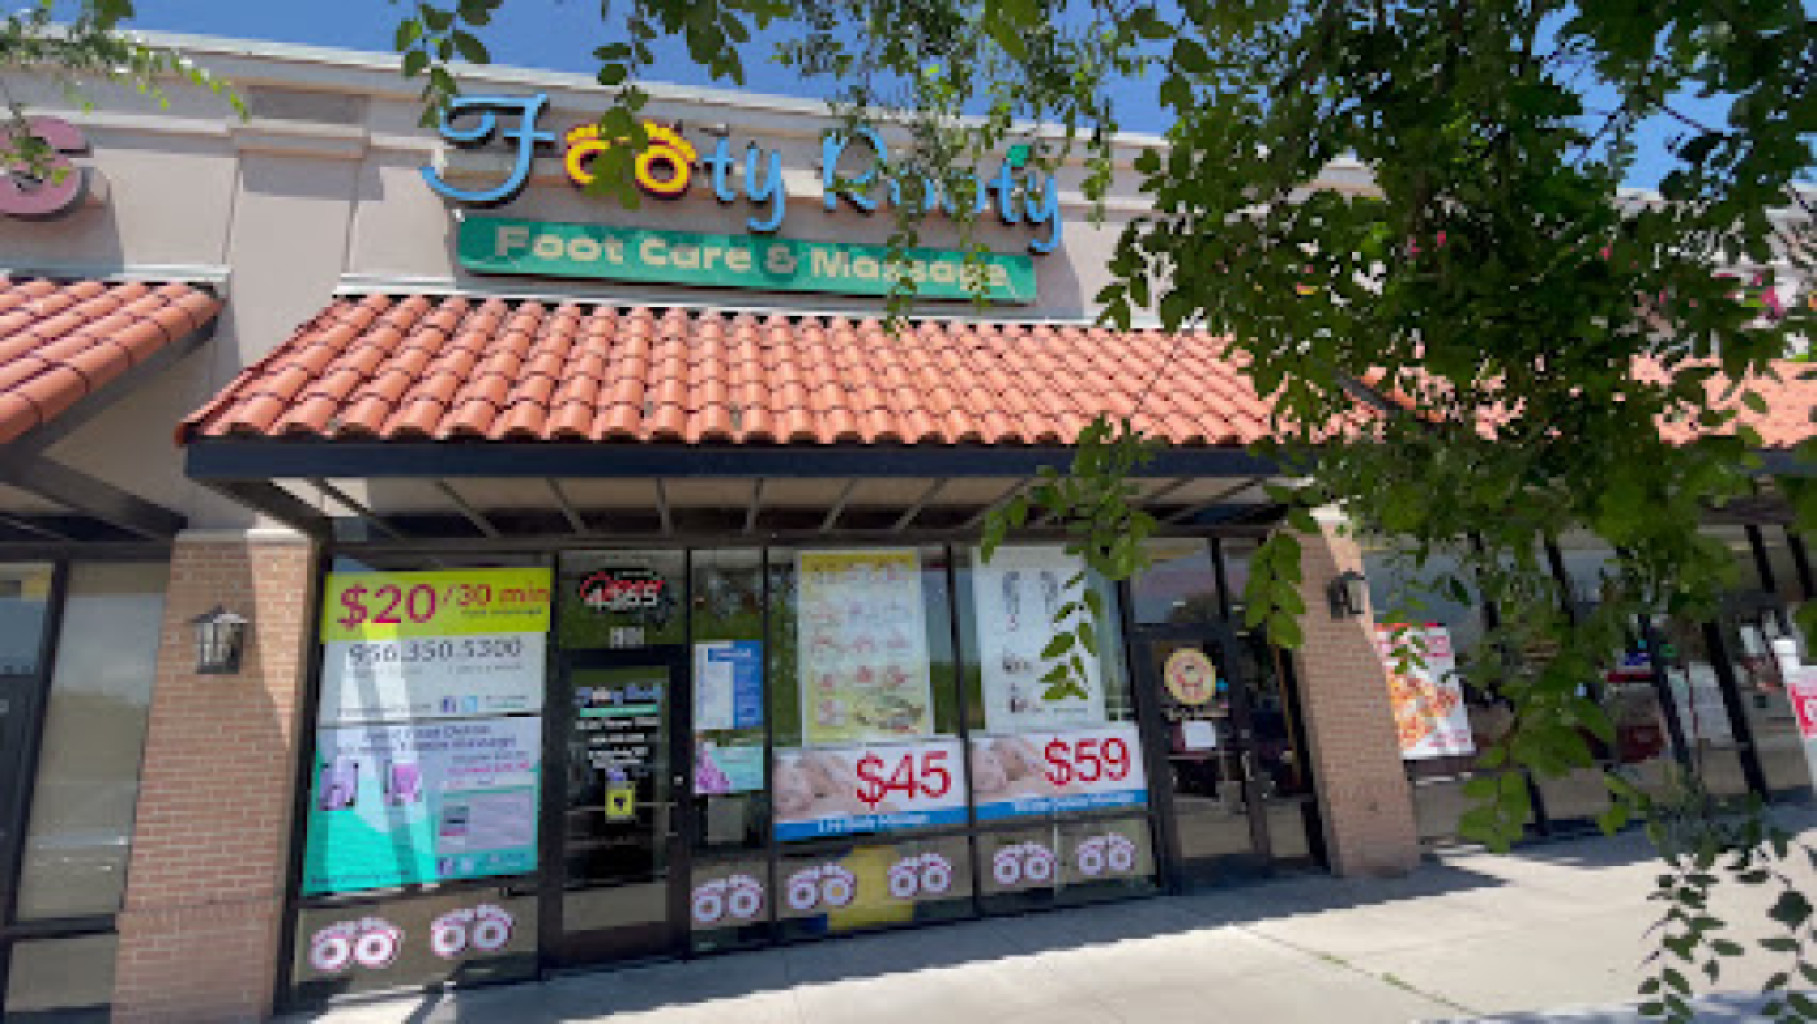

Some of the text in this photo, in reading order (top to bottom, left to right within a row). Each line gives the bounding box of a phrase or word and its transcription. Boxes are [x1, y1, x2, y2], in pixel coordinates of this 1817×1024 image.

[495, 226, 624, 266] Foot
[638, 236, 755, 273] Care
[763, 244, 797, 274] &
[337, 583, 437, 632] $20
[855, 750, 952, 810] $45
[1043, 736, 1132, 787] $59
